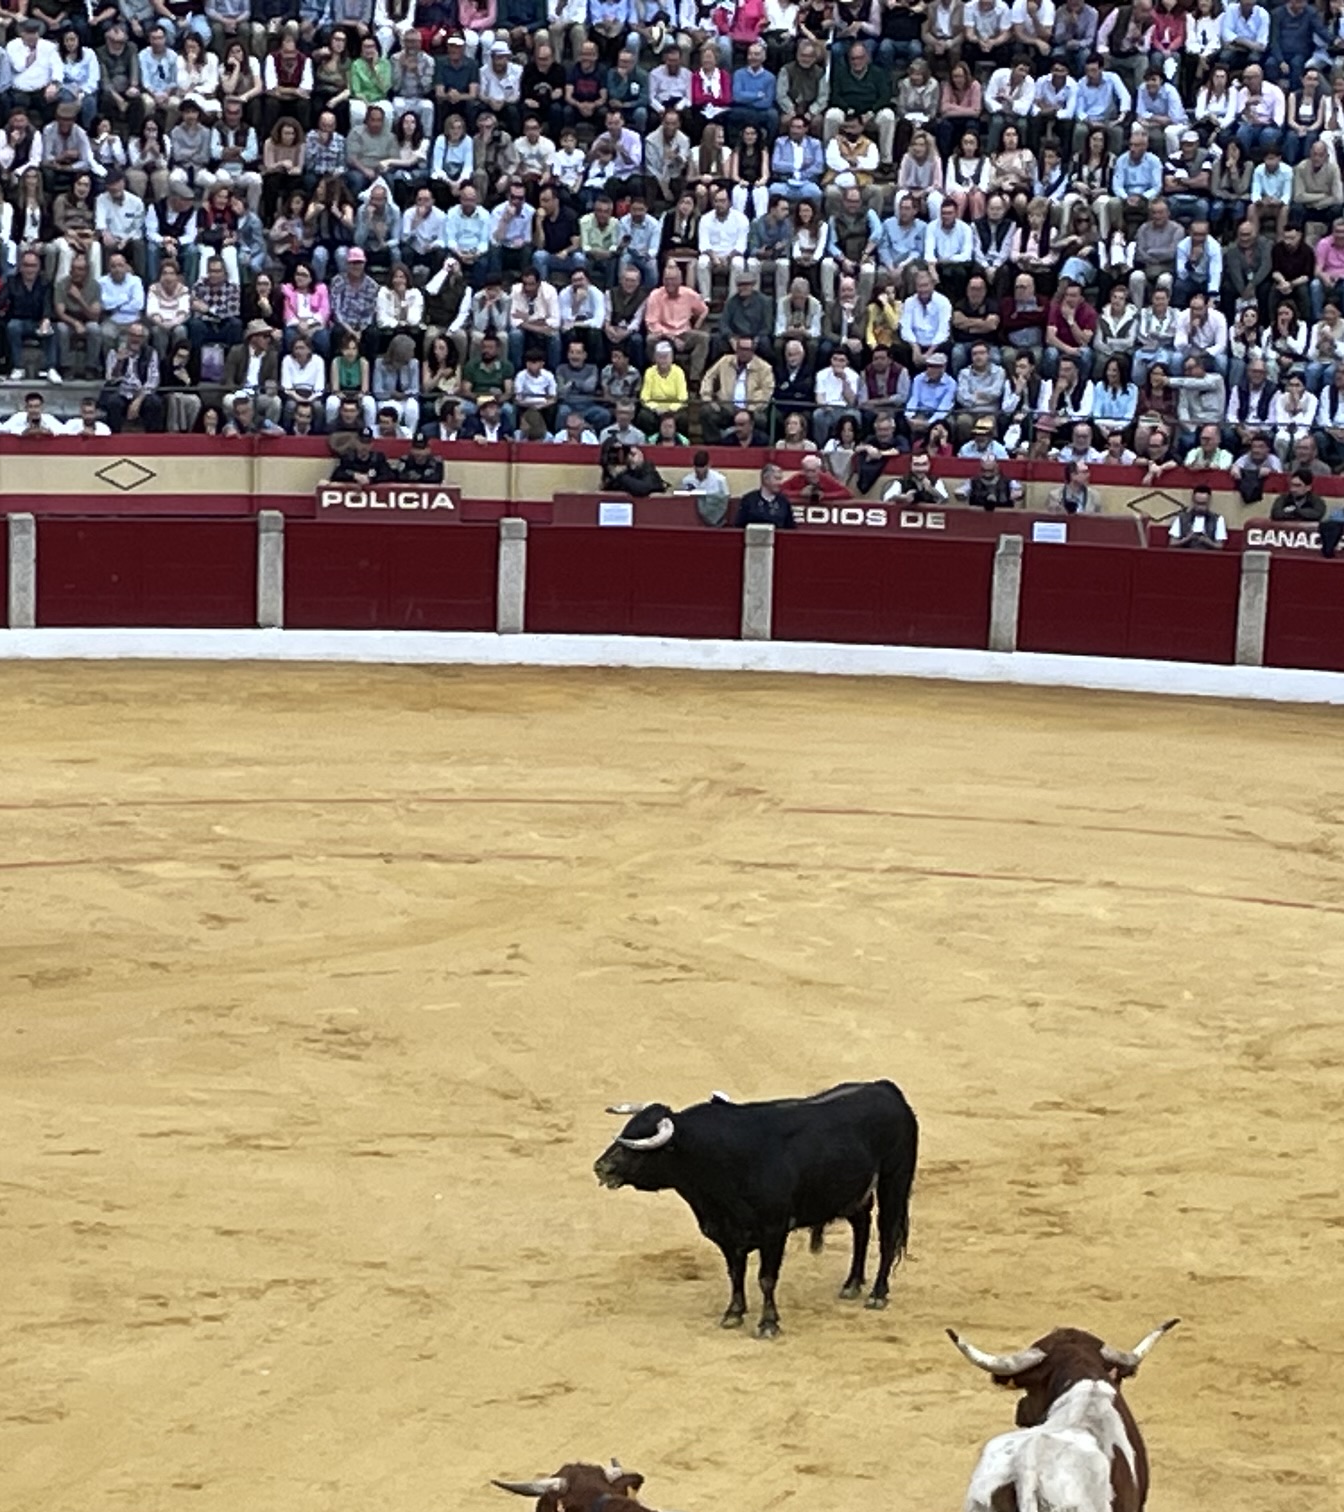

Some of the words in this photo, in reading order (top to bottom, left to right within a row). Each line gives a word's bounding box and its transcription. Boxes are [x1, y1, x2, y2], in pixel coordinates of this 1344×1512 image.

[321, 490, 455, 510] POLICIA
[791, 505, 888, 527] EDIOS
[900, 511, 946, 530] DE
